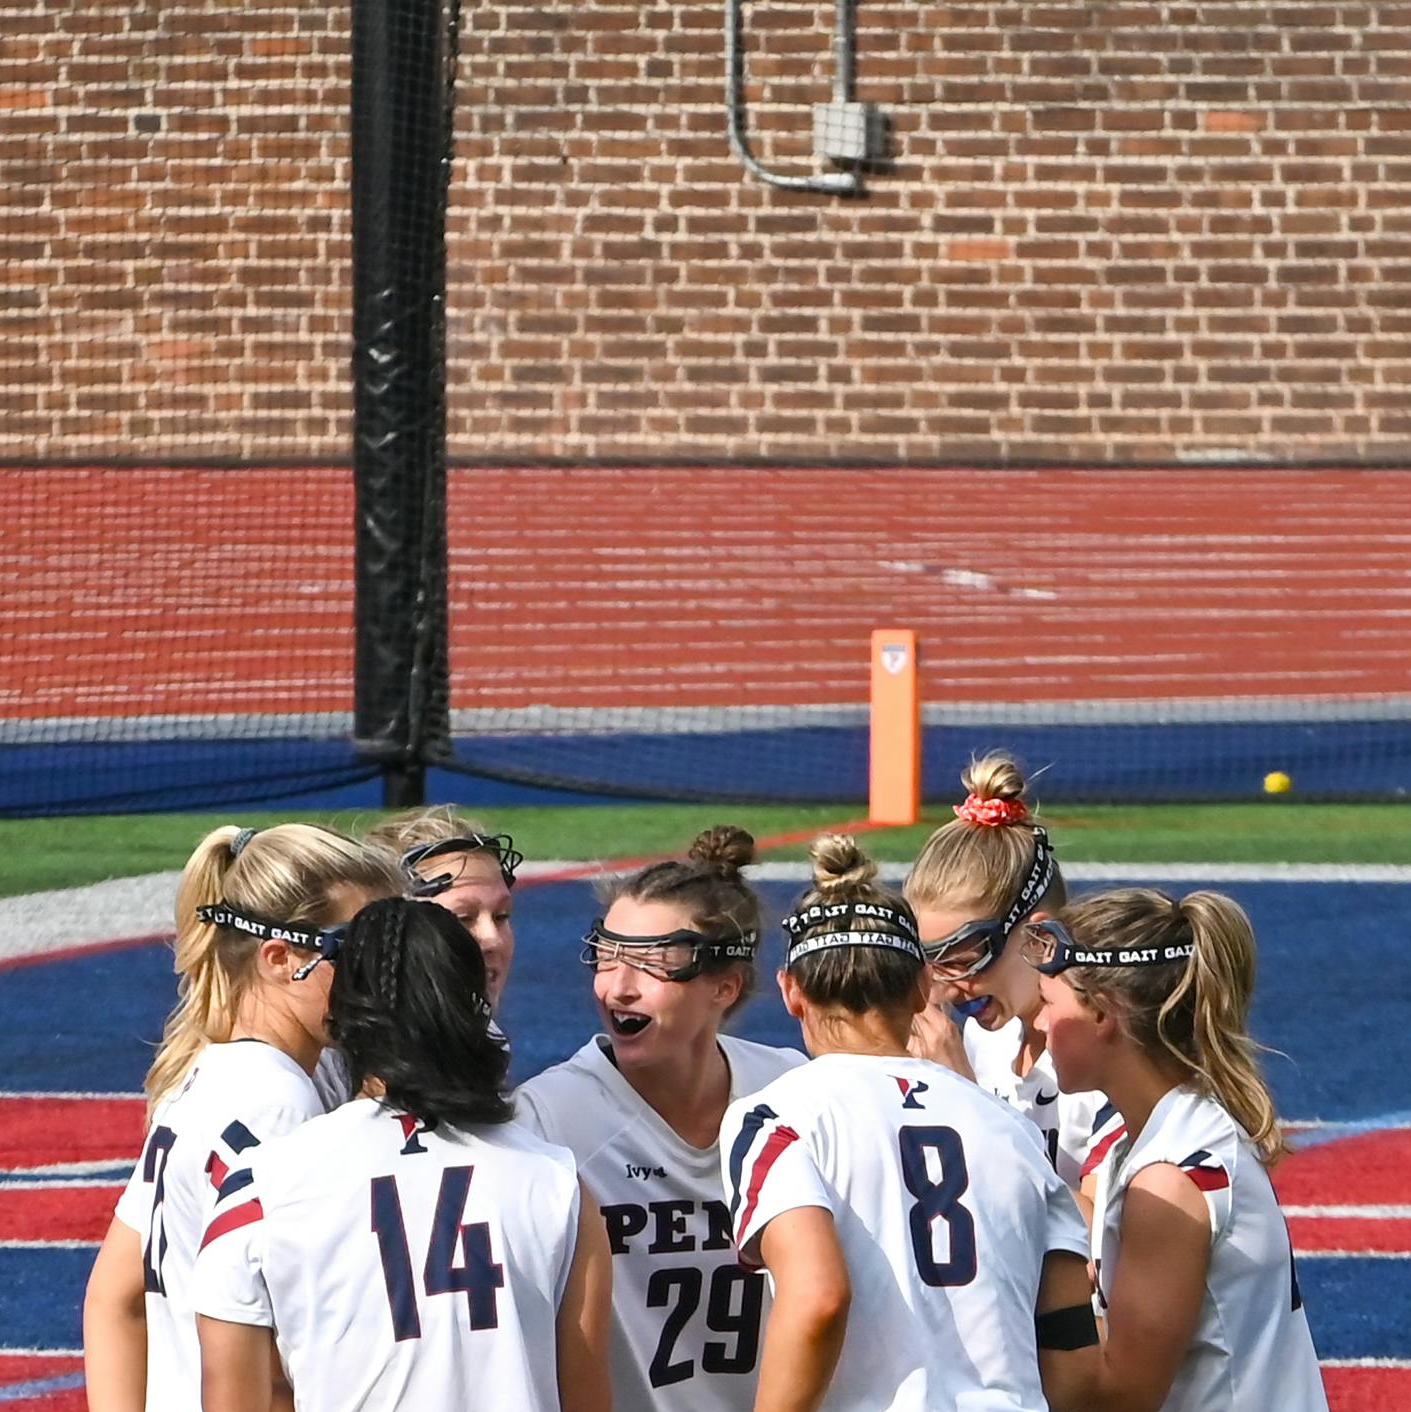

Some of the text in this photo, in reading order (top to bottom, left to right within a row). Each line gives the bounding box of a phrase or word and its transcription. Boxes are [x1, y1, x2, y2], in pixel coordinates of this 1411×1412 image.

[855, 904, 894, 919] GAIT
[1003, 904, 1021, 935] AIT
[1021, 862, 1042, 901] GAIT
[234, 916, 266, 936] GAIT
[271, 928, 309, 944] GAIT
[1075, 952, 1112, 963] GAIT
[1119, 949, 1158, 963] GAIT
[626, 1163, 652, 1181] Ivy
[898, 1125, 978, 1287] 8
[370, 1165, 504, 1343] 14
[646, 1264, 765, 1389] 29
